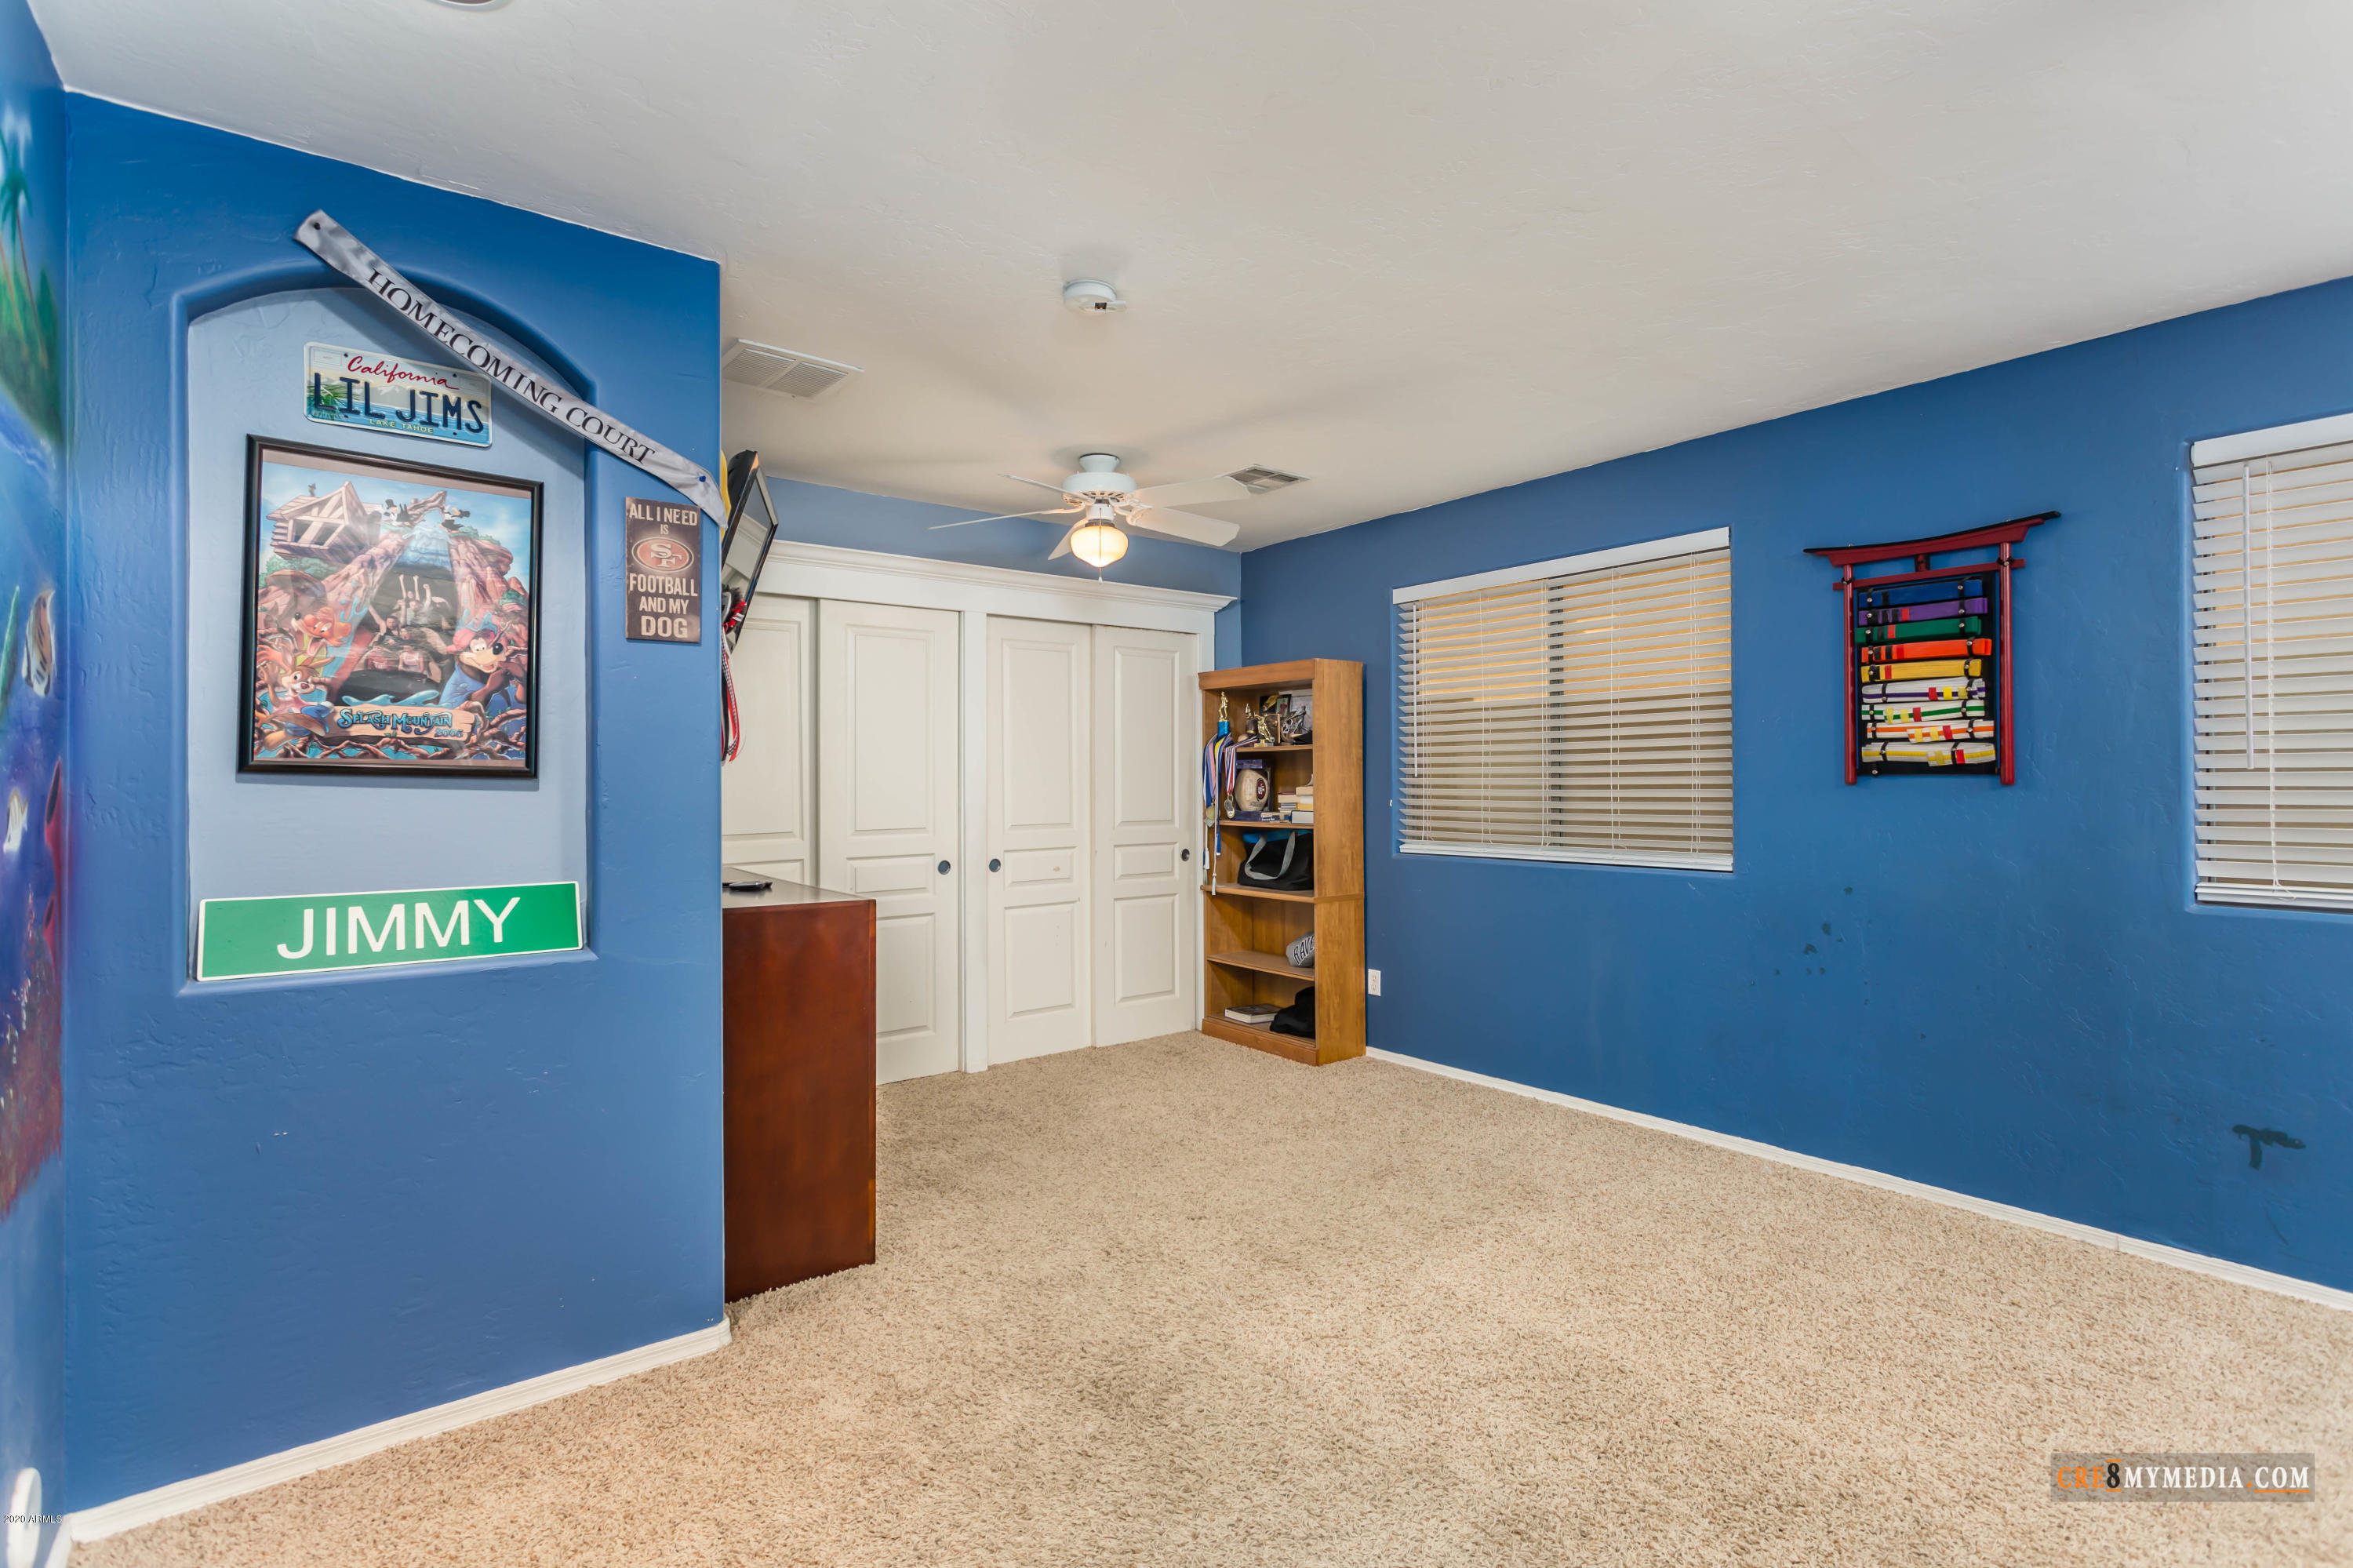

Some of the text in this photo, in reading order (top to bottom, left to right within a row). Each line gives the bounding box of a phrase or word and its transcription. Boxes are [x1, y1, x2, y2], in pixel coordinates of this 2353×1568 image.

[347, 355, 460, 390] California
[367, 267, 656, 464] HOMECOMING COURT
[314, 373, 484, 433] LIL JIMS
[369, 418, 434, 433] LAKE TAHOE
[629, 503, 698, 526] ALL I NEED
[660, 524, 669, 535] IS
[650, 542, 682, 568] SF
[629, 573, 698, 597] FOOTBALL
[639, 595, 689, 615] AND MY
[641, 615, 689, 638] DOG
[336, 708, 453, 736] SPLASH MOUNTAIN
[276, 897, 521, 959] JIMMY
